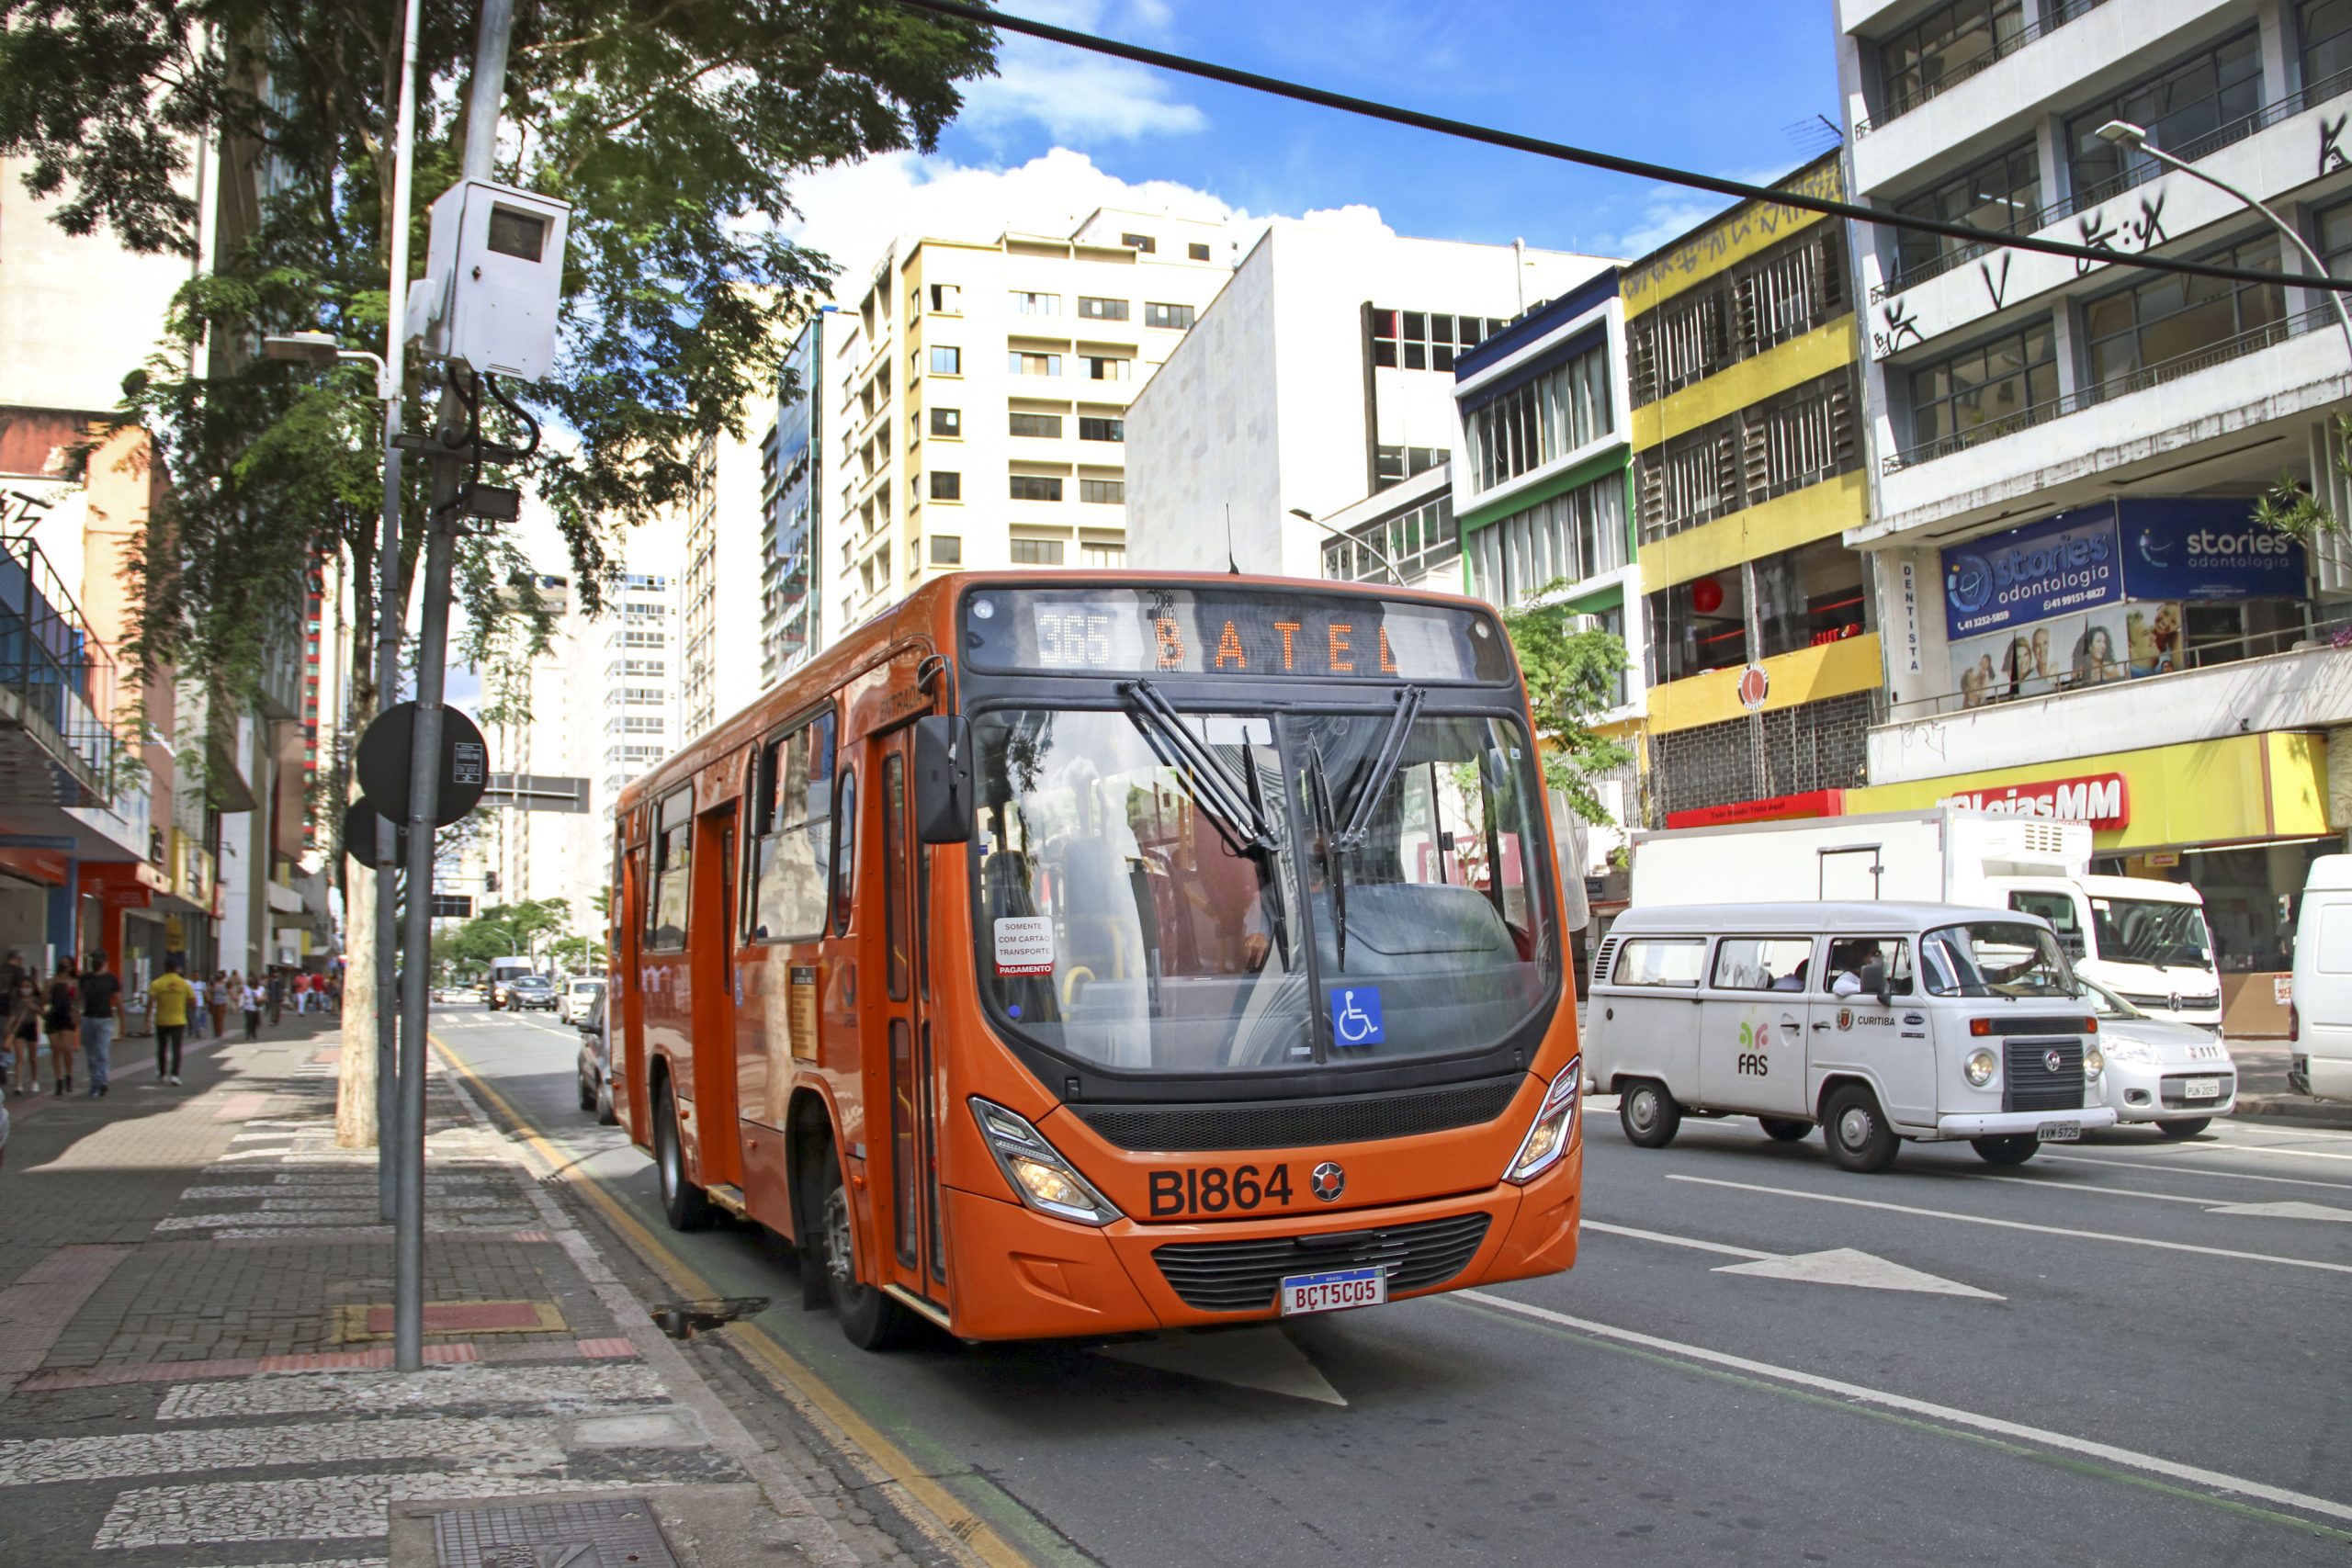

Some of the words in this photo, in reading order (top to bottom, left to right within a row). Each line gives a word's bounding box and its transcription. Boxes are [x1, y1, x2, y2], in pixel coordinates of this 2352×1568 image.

[2186, 528, 2289, 555] stories
[1996, 533, 2109, 586] stories
[2188, 555, 2290, 570] odontologia
[1998, 565, 2109, 604] odontologia
[1904, 566, 1918, 670] DENTISTA
[1039, 615, 1109, 663] 365
[1156, 617, 1399, 672] BATEL
[999, 965, 1051, 974] PAGAMENTO
[1857, 1015, 1895, 1026] CURITIBA
[1738, 1054, 1769, 1077] FAS
[1148, 1163, 1294, 1217] BI864
[1295, 1280, 1375, 1309] BCT5C05
